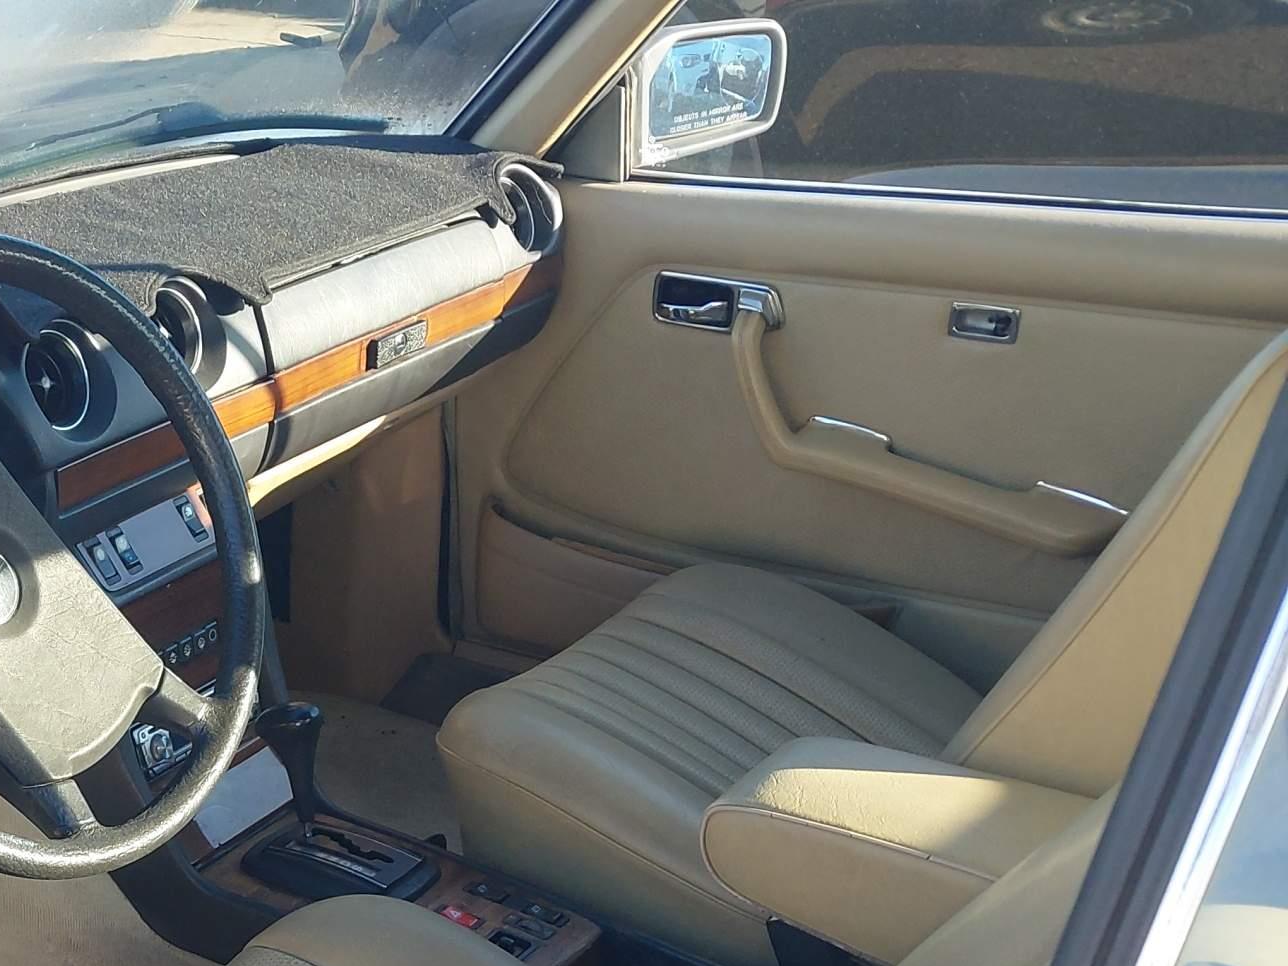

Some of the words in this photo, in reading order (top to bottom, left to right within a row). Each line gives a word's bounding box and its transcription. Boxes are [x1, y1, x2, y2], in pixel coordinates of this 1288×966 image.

[700, 109, 708, 118] IN
[693, 119, 709, 129] THAN
[710, 116, 725, 125] THEY
